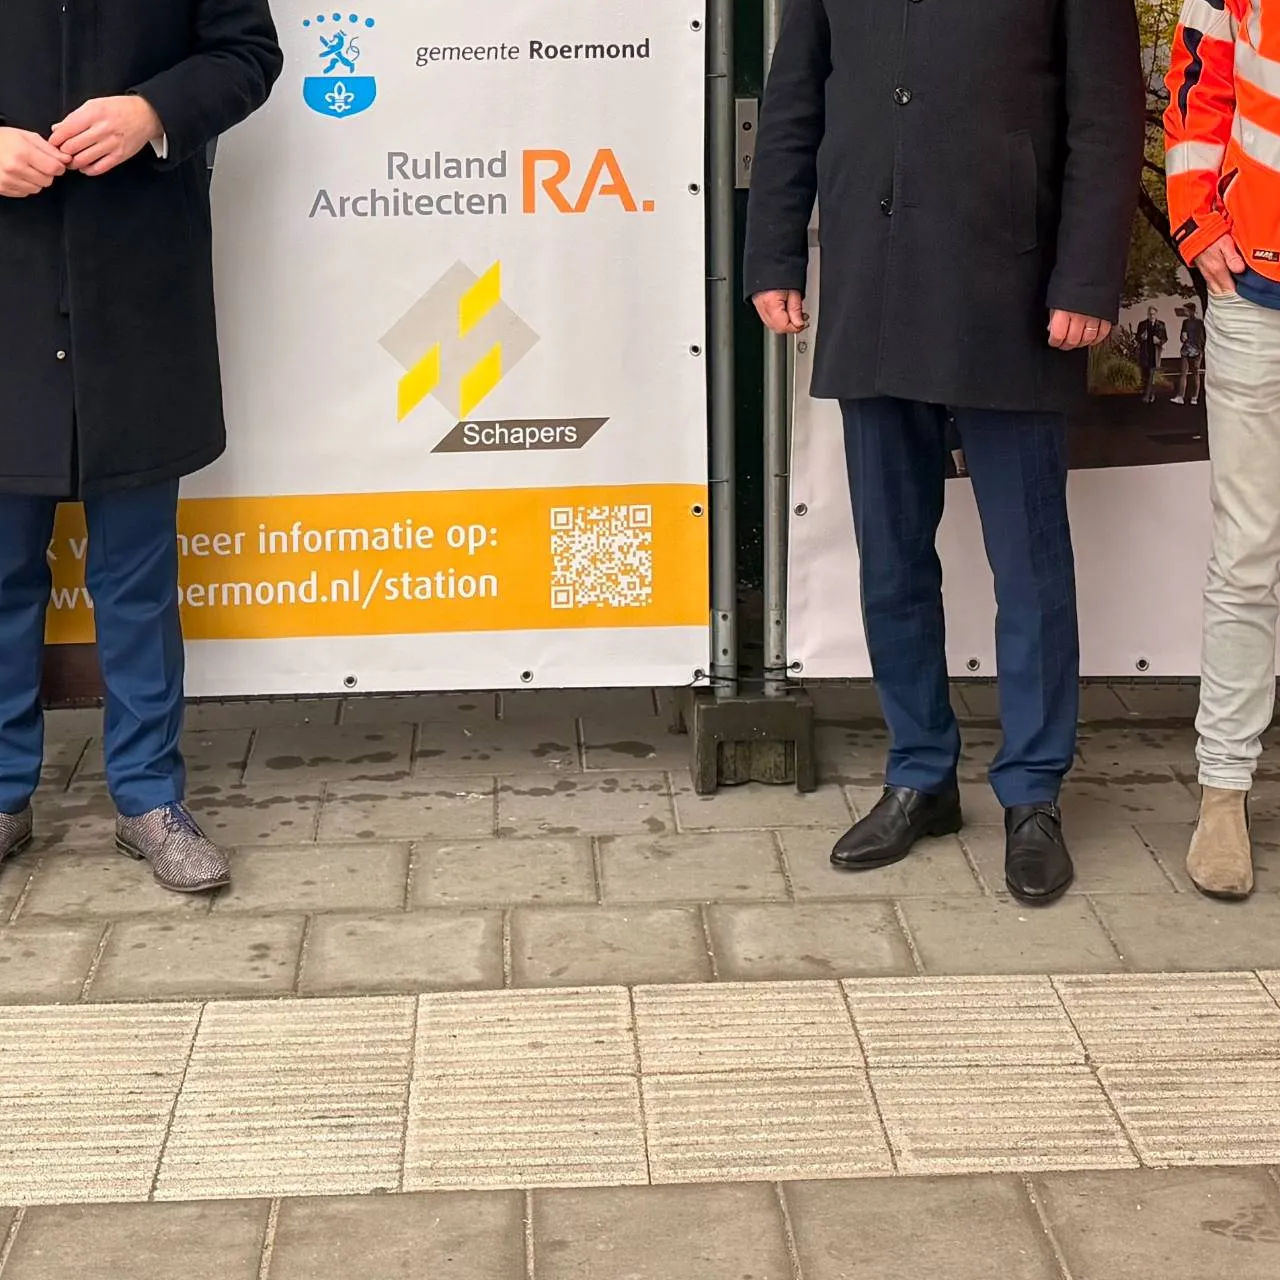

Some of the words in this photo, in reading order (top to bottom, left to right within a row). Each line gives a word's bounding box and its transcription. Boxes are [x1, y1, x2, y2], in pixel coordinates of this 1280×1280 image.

[415, 42, 520, 67] gemeente
[529, 38, 650, 60] Roermond
[387, 150, 507, 180] Ruland
[308, 188, 507, 218] Architecten
[463, 423, 577, 448] Schapers
[258, 519, 435, 555] informatie
[446, 522, 499, 555] op:
